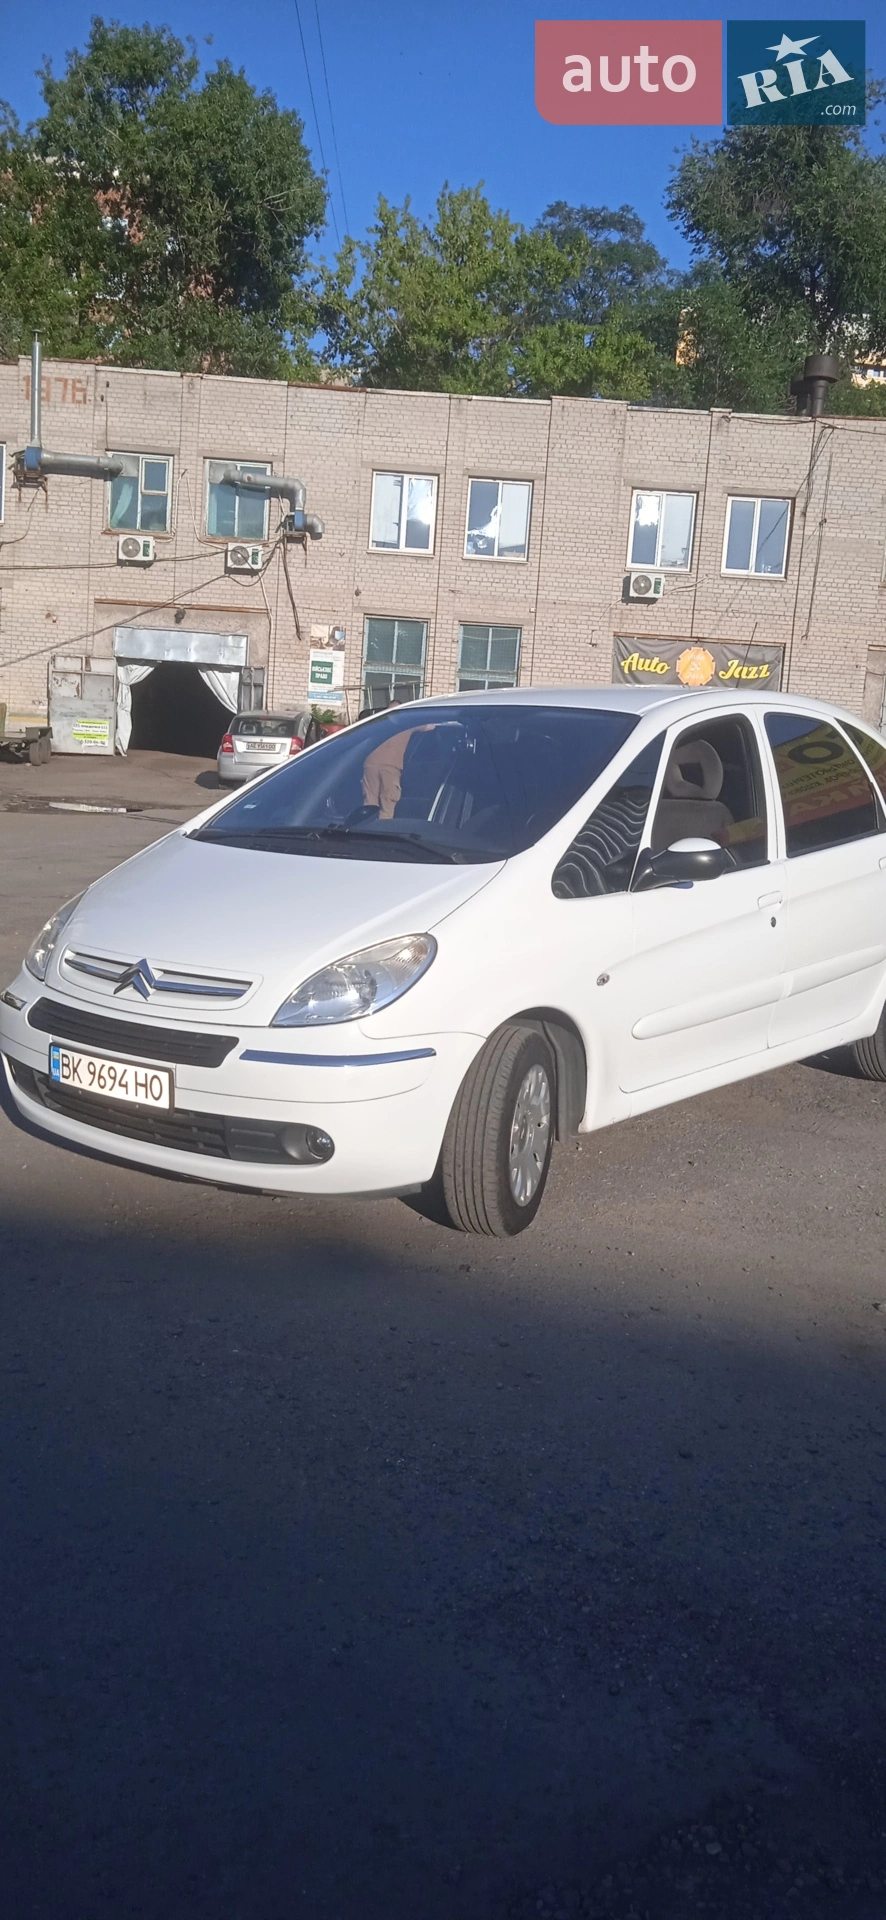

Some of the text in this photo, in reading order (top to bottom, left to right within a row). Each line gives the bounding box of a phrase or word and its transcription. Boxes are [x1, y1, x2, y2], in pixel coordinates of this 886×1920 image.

[620, 653, 770, 680] Auto Jazz
[52, 1068, 60, 1077] UA
[61, 1053, 163, 1101] BK 9694 HO
